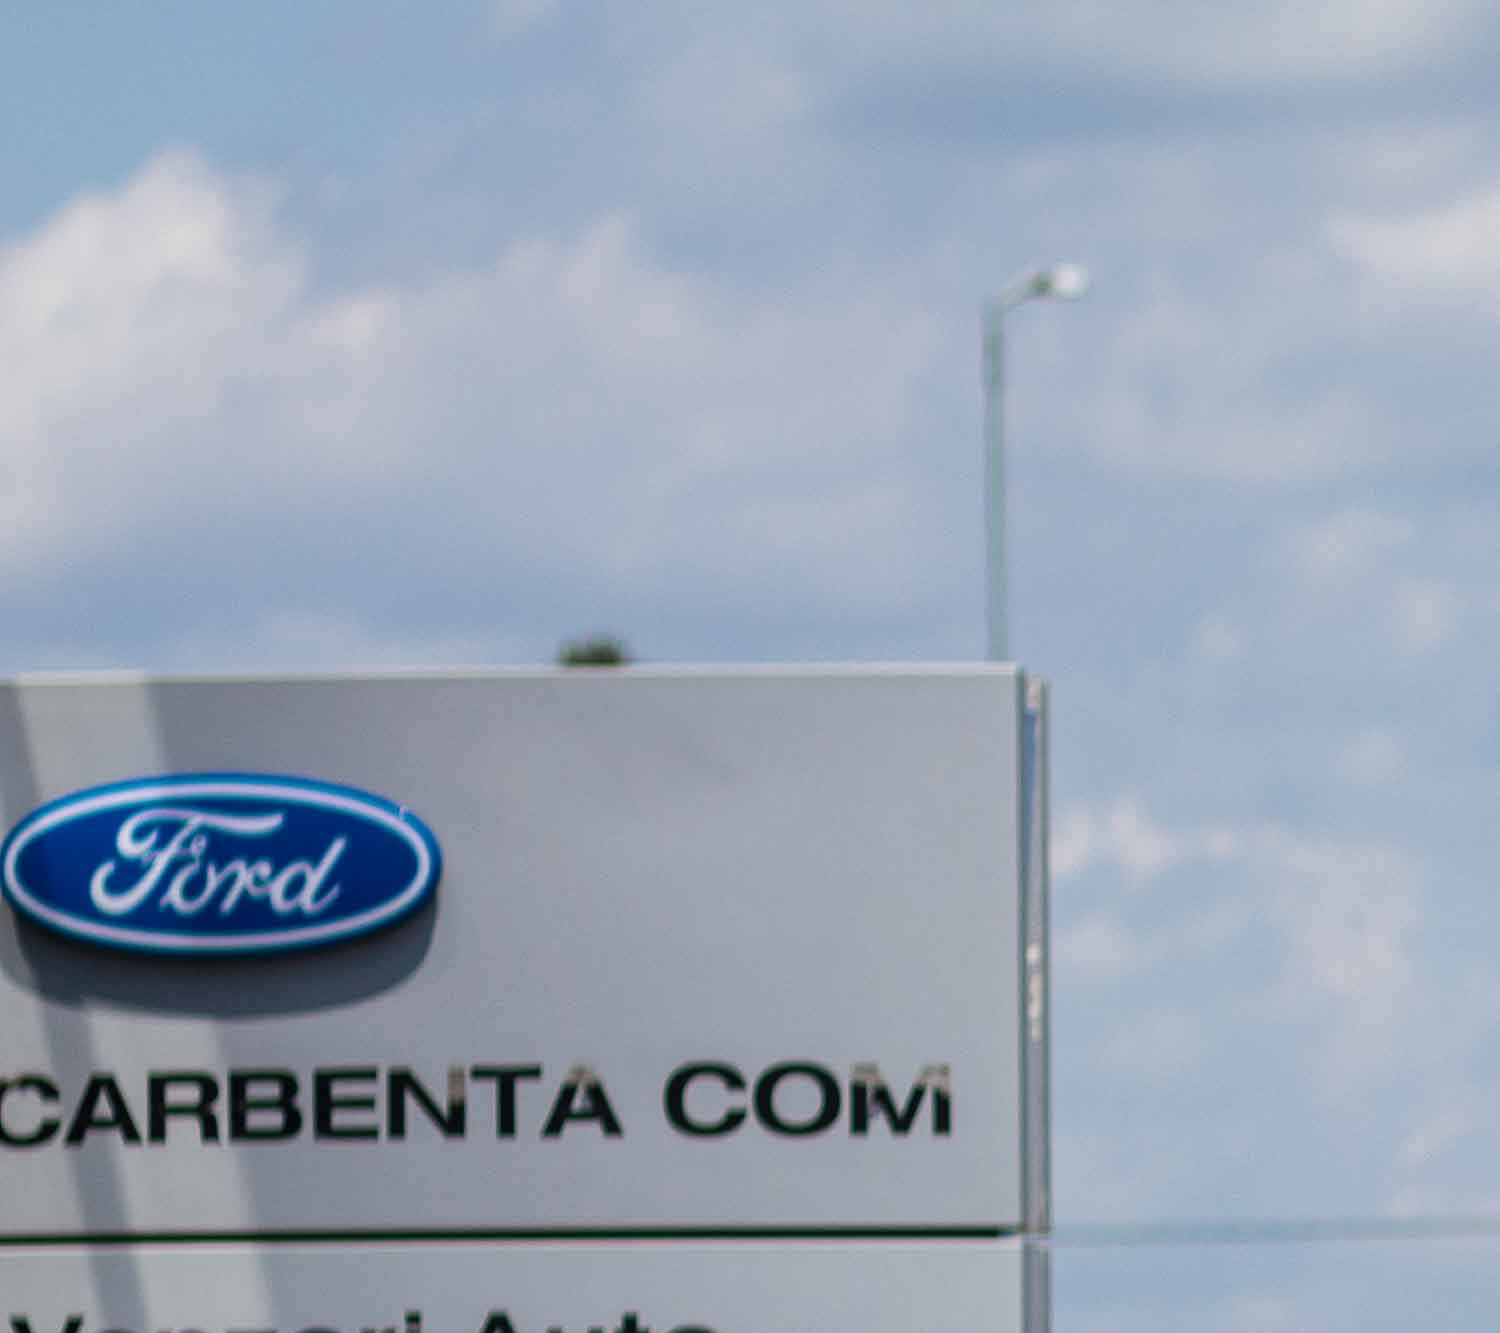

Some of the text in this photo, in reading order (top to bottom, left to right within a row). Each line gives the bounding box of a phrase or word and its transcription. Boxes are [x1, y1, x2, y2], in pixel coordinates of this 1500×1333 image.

[90, 806, 347, 916] Ford
[0, 1060, 953, 1149] CARBENTA COM
